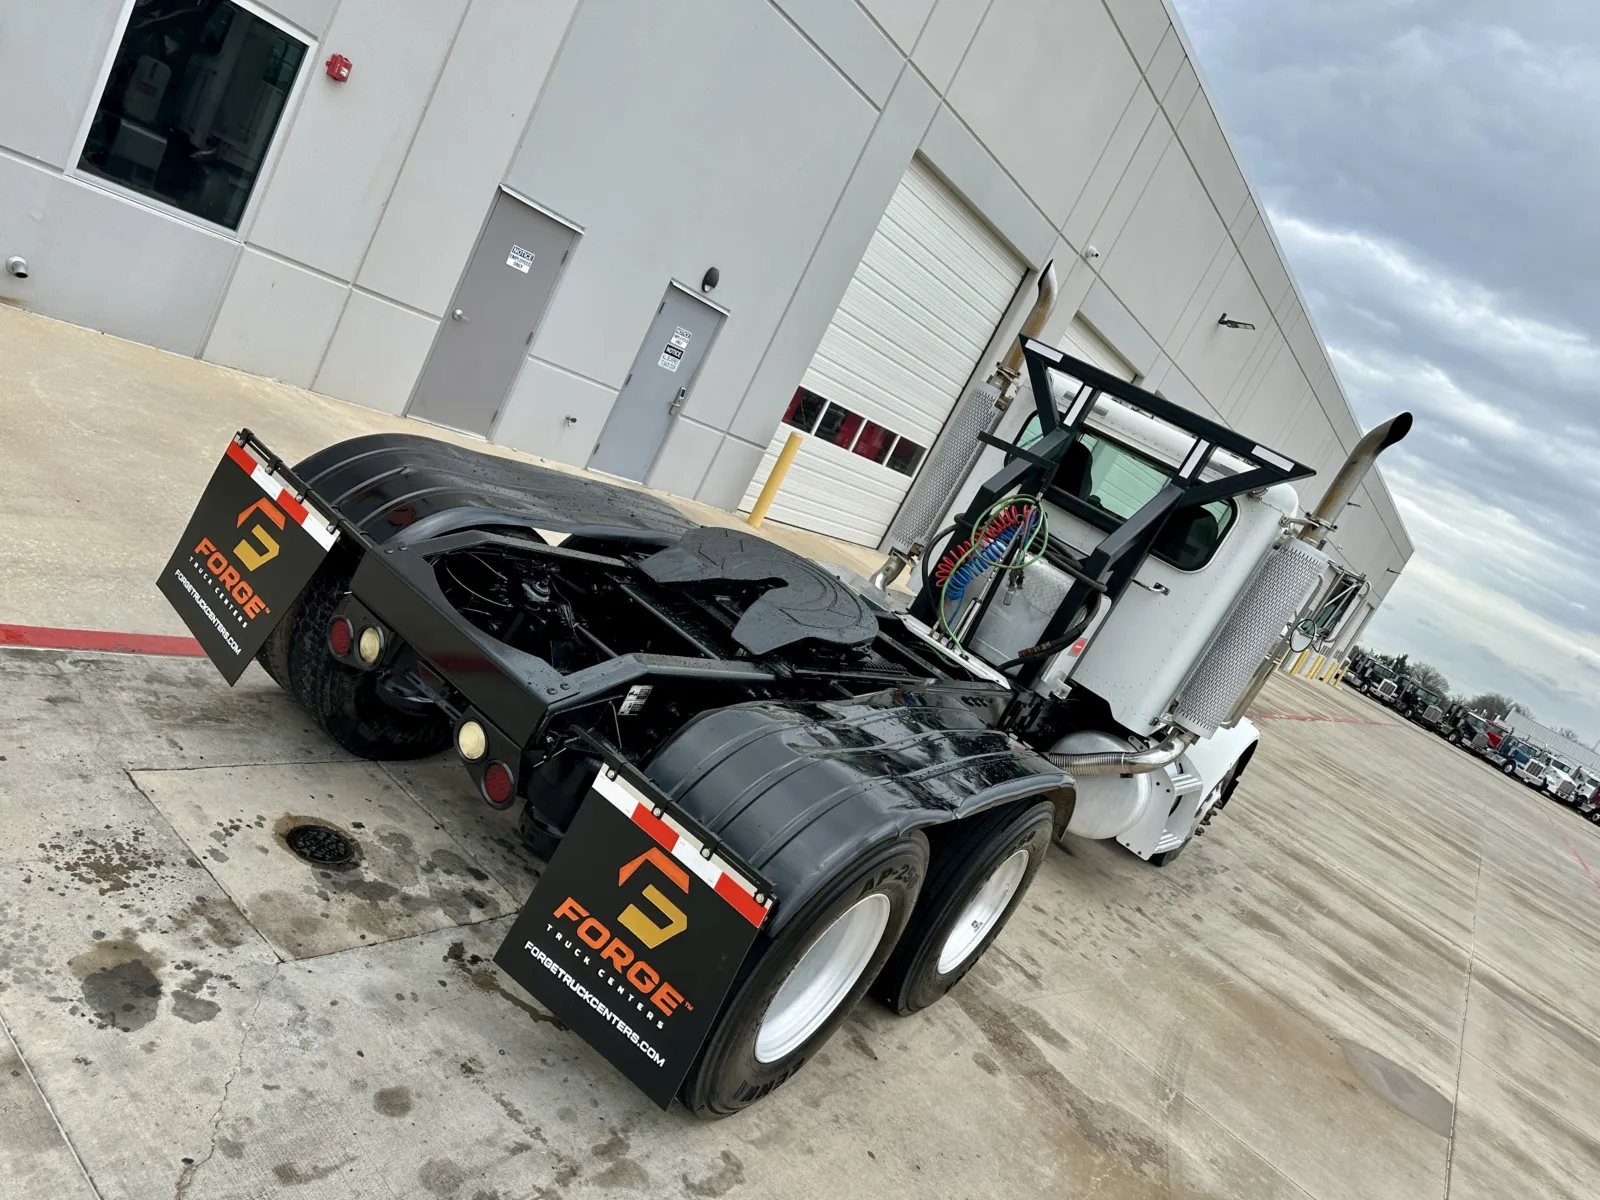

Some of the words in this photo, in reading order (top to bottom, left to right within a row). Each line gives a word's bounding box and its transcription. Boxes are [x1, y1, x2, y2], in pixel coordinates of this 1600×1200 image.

[511, 246, 533, 261] NOTICE
[666, 346, 681, 358] NOTICE
[174, 569, 242, 655] FORGETRUCKCENTERS.COM
[188, 555, 212, 585] TRUCK
[214, 587, 248, 629] CENTERS
[194, 537, 266, 619] FORGE
[546, 923, 591, 965] TRUCK
[598, 968, 665, 1029] CENTERS
[553, 896, 685, 1017] FORGE
[524, 940, 666, 1068] FORGETRUCKCENTERS.COM
